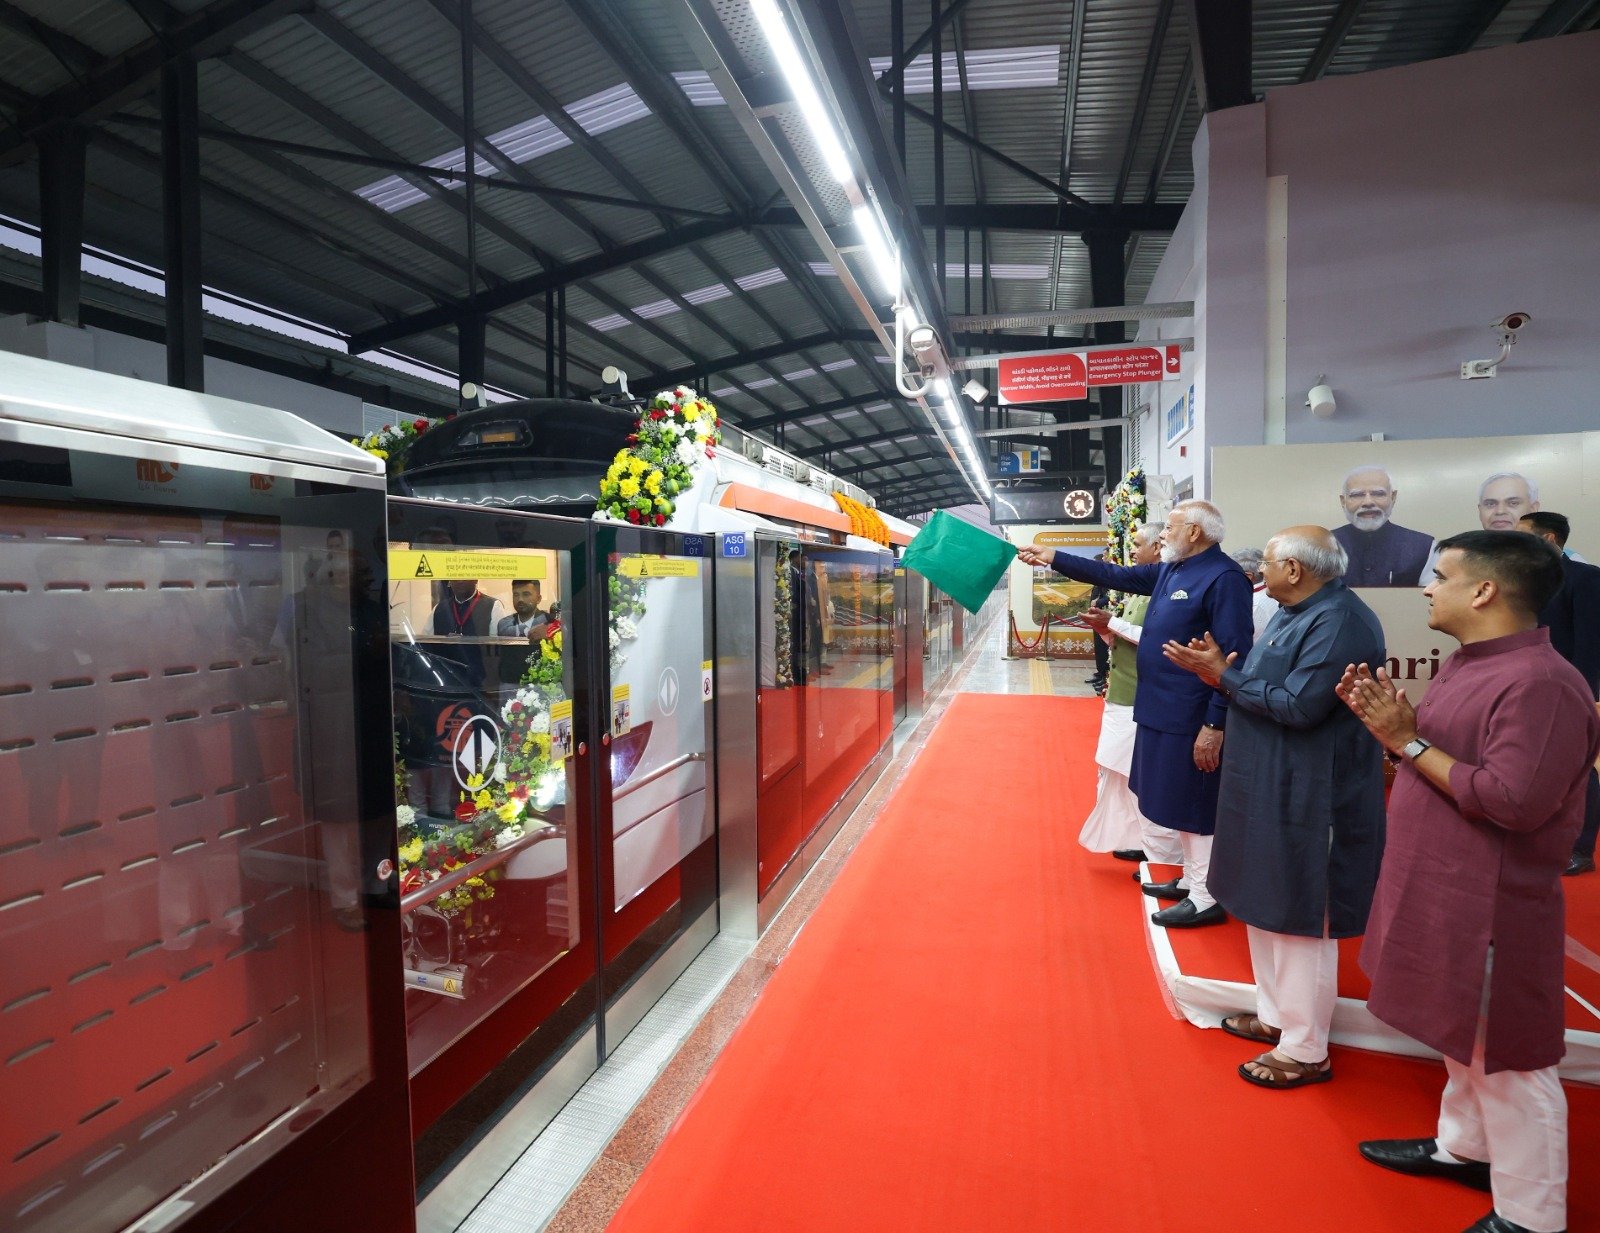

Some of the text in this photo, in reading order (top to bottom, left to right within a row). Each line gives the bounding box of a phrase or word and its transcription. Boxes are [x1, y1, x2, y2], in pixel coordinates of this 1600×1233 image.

[725, 536, 743, 544] ASG
[729, 546, 740, 555] 10
[1384, 648, 1440, 680] hri
